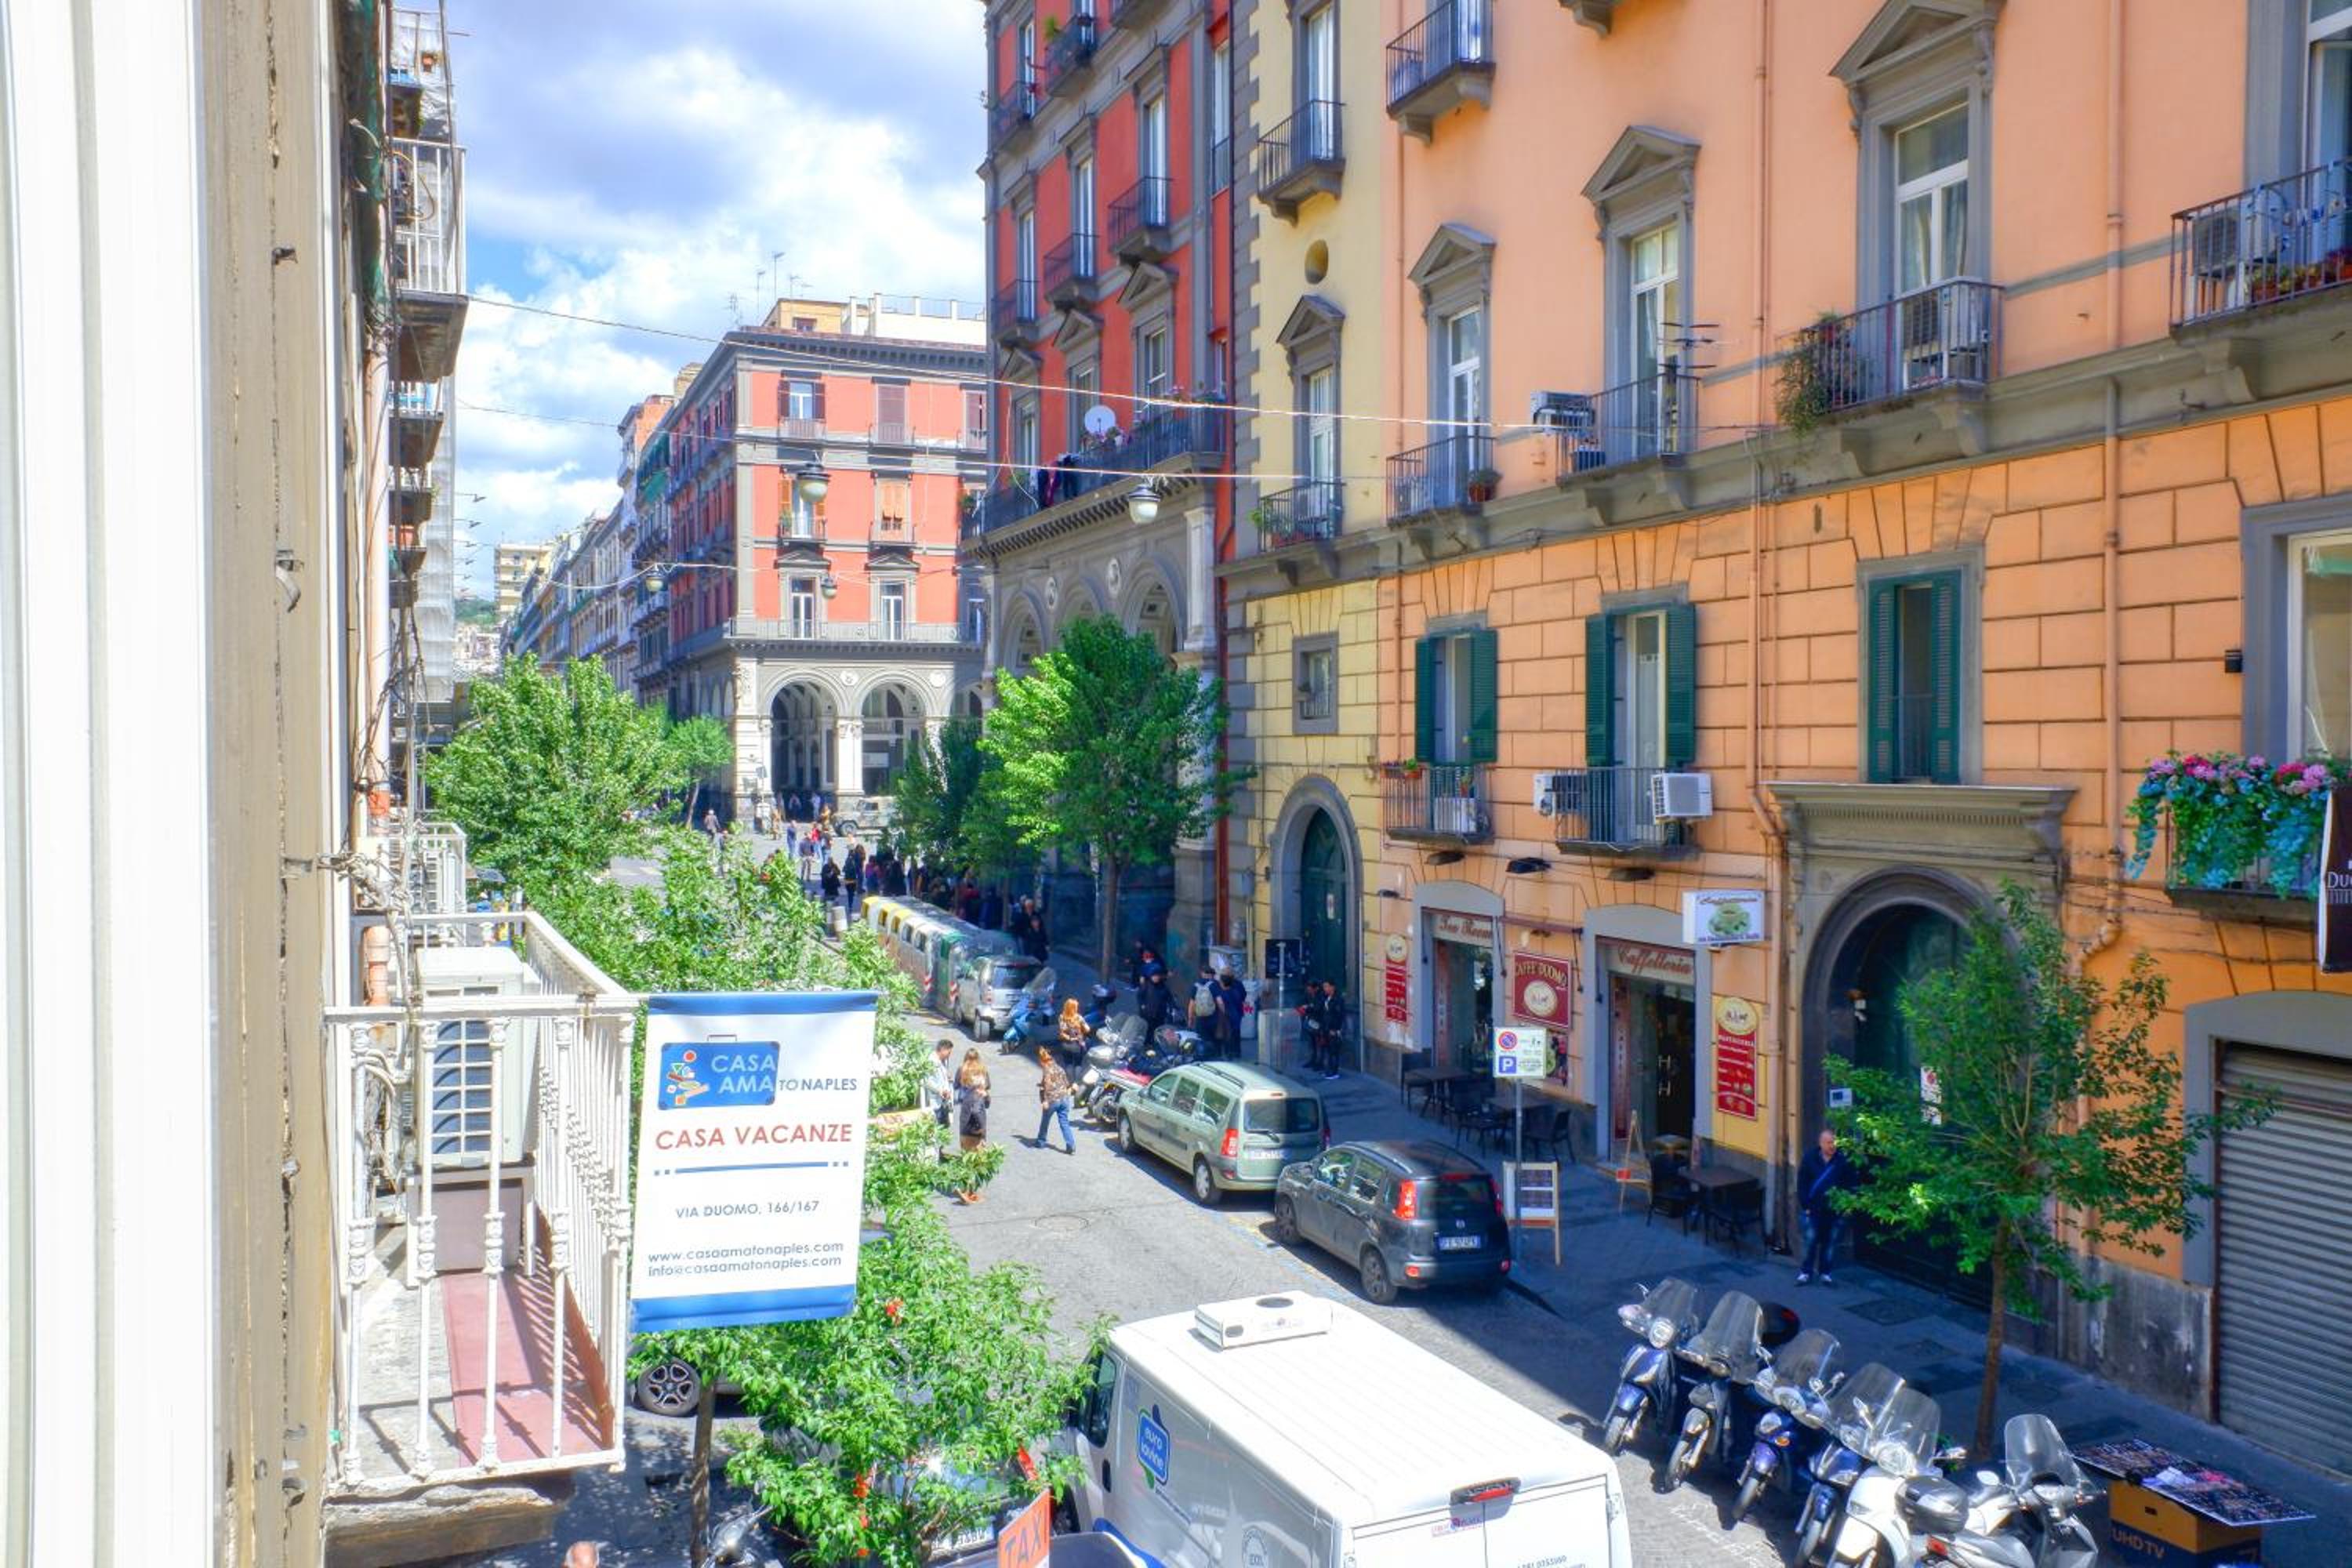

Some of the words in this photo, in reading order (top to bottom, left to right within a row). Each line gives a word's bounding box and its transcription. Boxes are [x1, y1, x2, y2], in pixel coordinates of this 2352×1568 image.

[2328, 872, 2352, 888] DU
[711, 1053, 776, 1073] CASA
[1501, 1058, 1514, 1072] P
[655, 1127, 725, 1150] CASA
[735, 1124, 853, 1144] VACANZE
[675, 1207, 699, 1218] VIA
[768, 1200, 820, 1214] 166/167
[648, 1242, 844, 1262] www.casaamatonaples.com
[648, 1256, 842, 1277] info@casaamatonaples.com
[2111, 1526, 2142, 1551] UHD
[2143, 1541, 2165, 1559] TV
